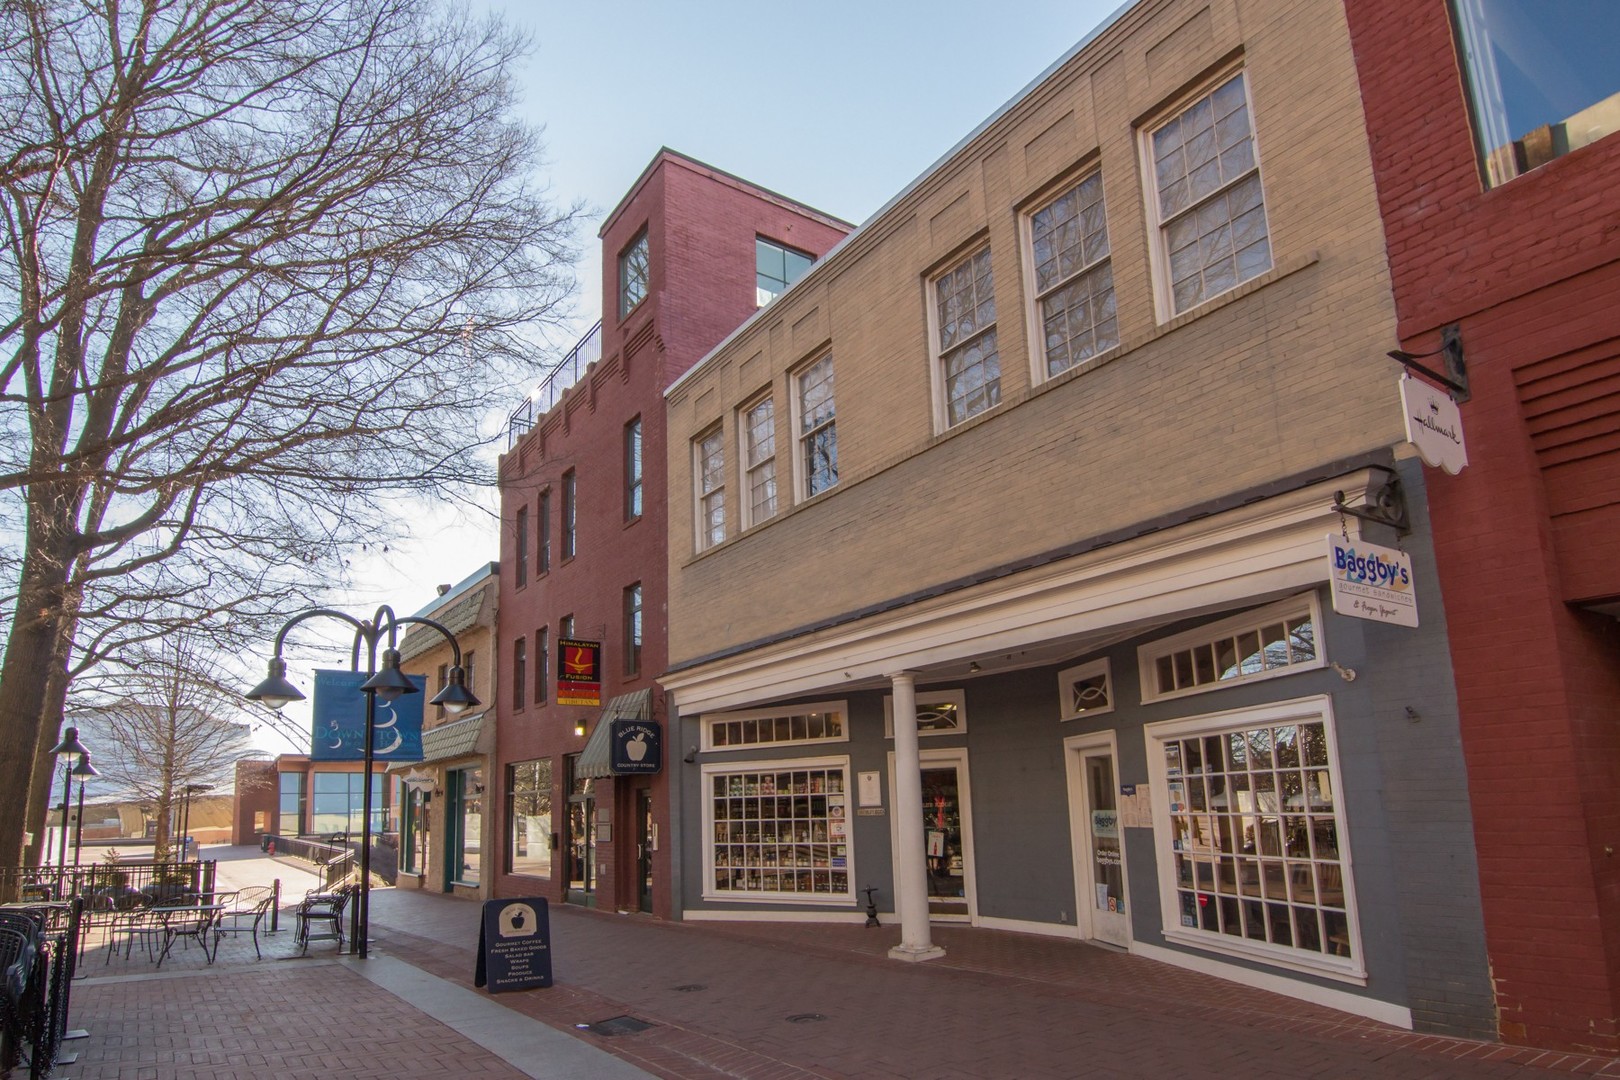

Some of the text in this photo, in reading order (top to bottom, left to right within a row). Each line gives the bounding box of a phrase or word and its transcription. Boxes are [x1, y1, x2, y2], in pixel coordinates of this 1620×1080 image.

[1335, 546, 1409, 586] Baggby's
[559, 640, 599, 648] HIMALAYAN
[565, 673, 593, 681] FUSION
[618, 725, 656, 739] BLUE RIDGE
